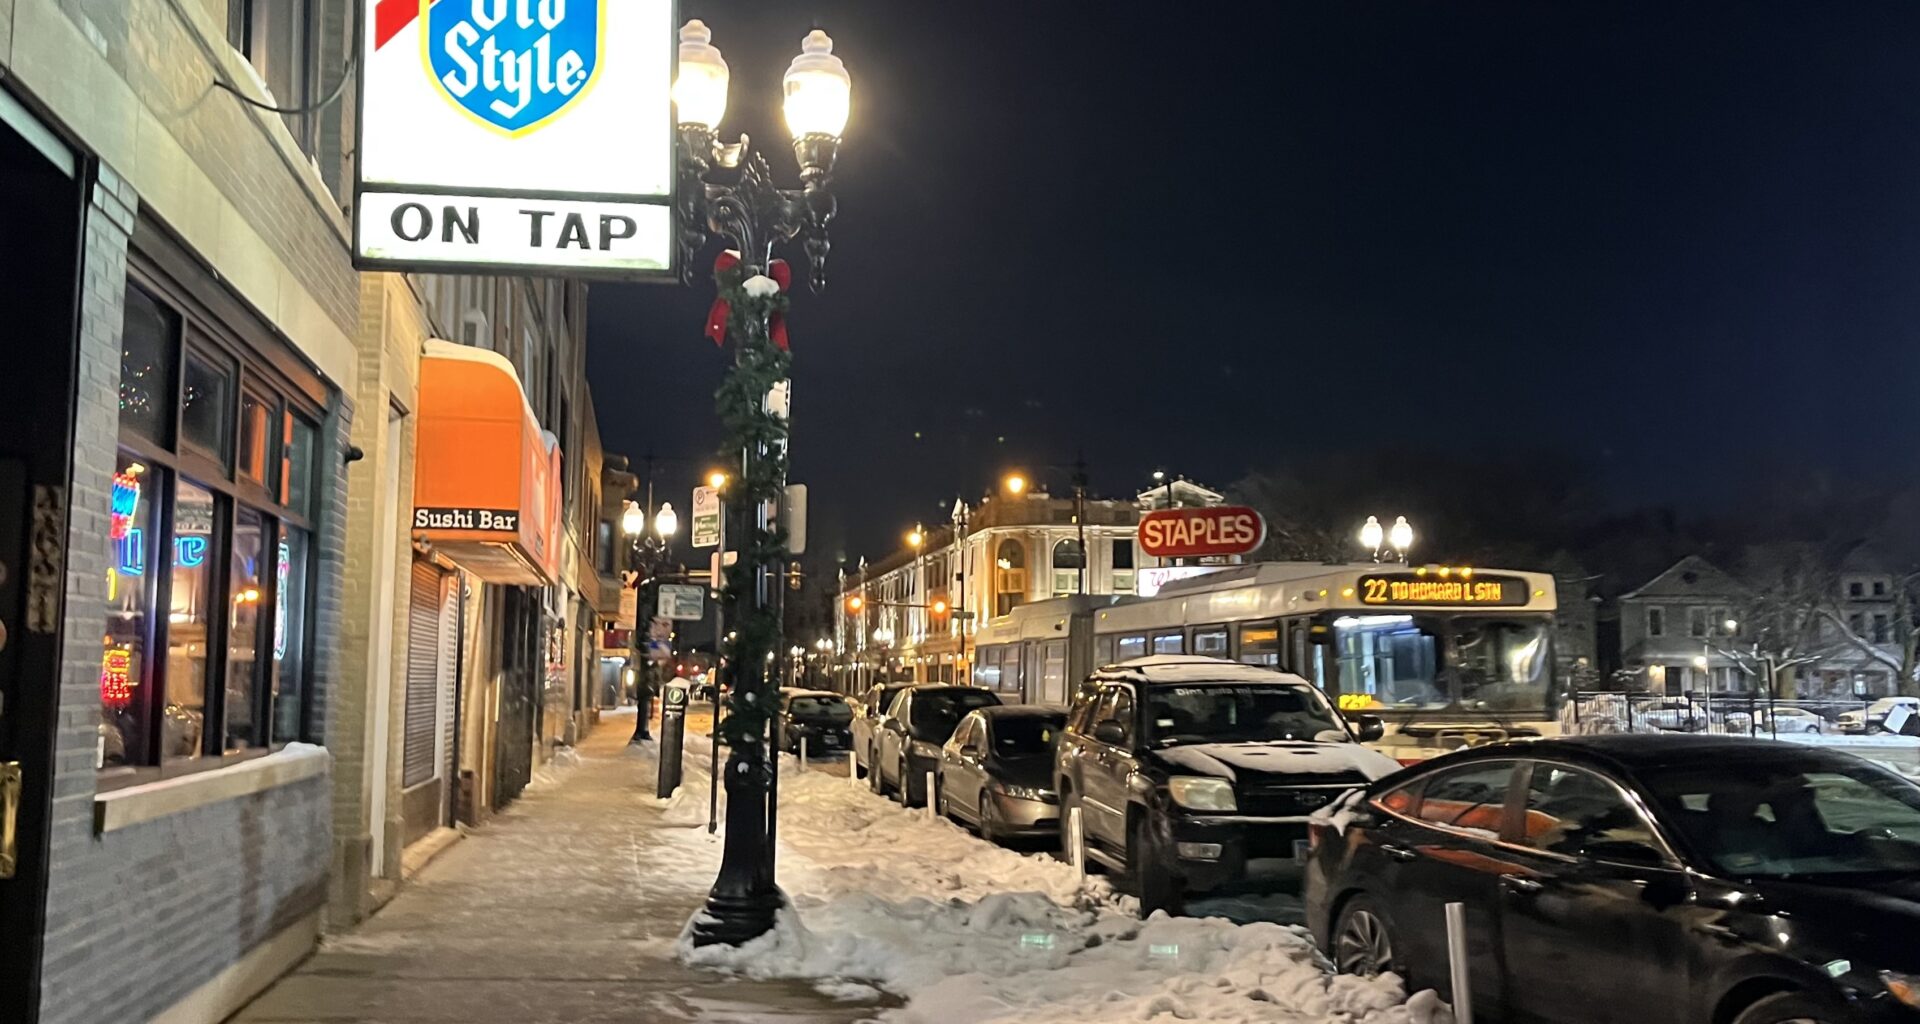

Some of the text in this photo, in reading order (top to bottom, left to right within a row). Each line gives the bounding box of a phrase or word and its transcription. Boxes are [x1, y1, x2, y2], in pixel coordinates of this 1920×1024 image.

[390, 202, 638, 251] ON TAP
[415, 509, 516, 530] Sushi Bar
[1144, 514, 1255, 548] STAPLES
[1364, 579, 1501, 601] 22 TO HOWARD L STN
